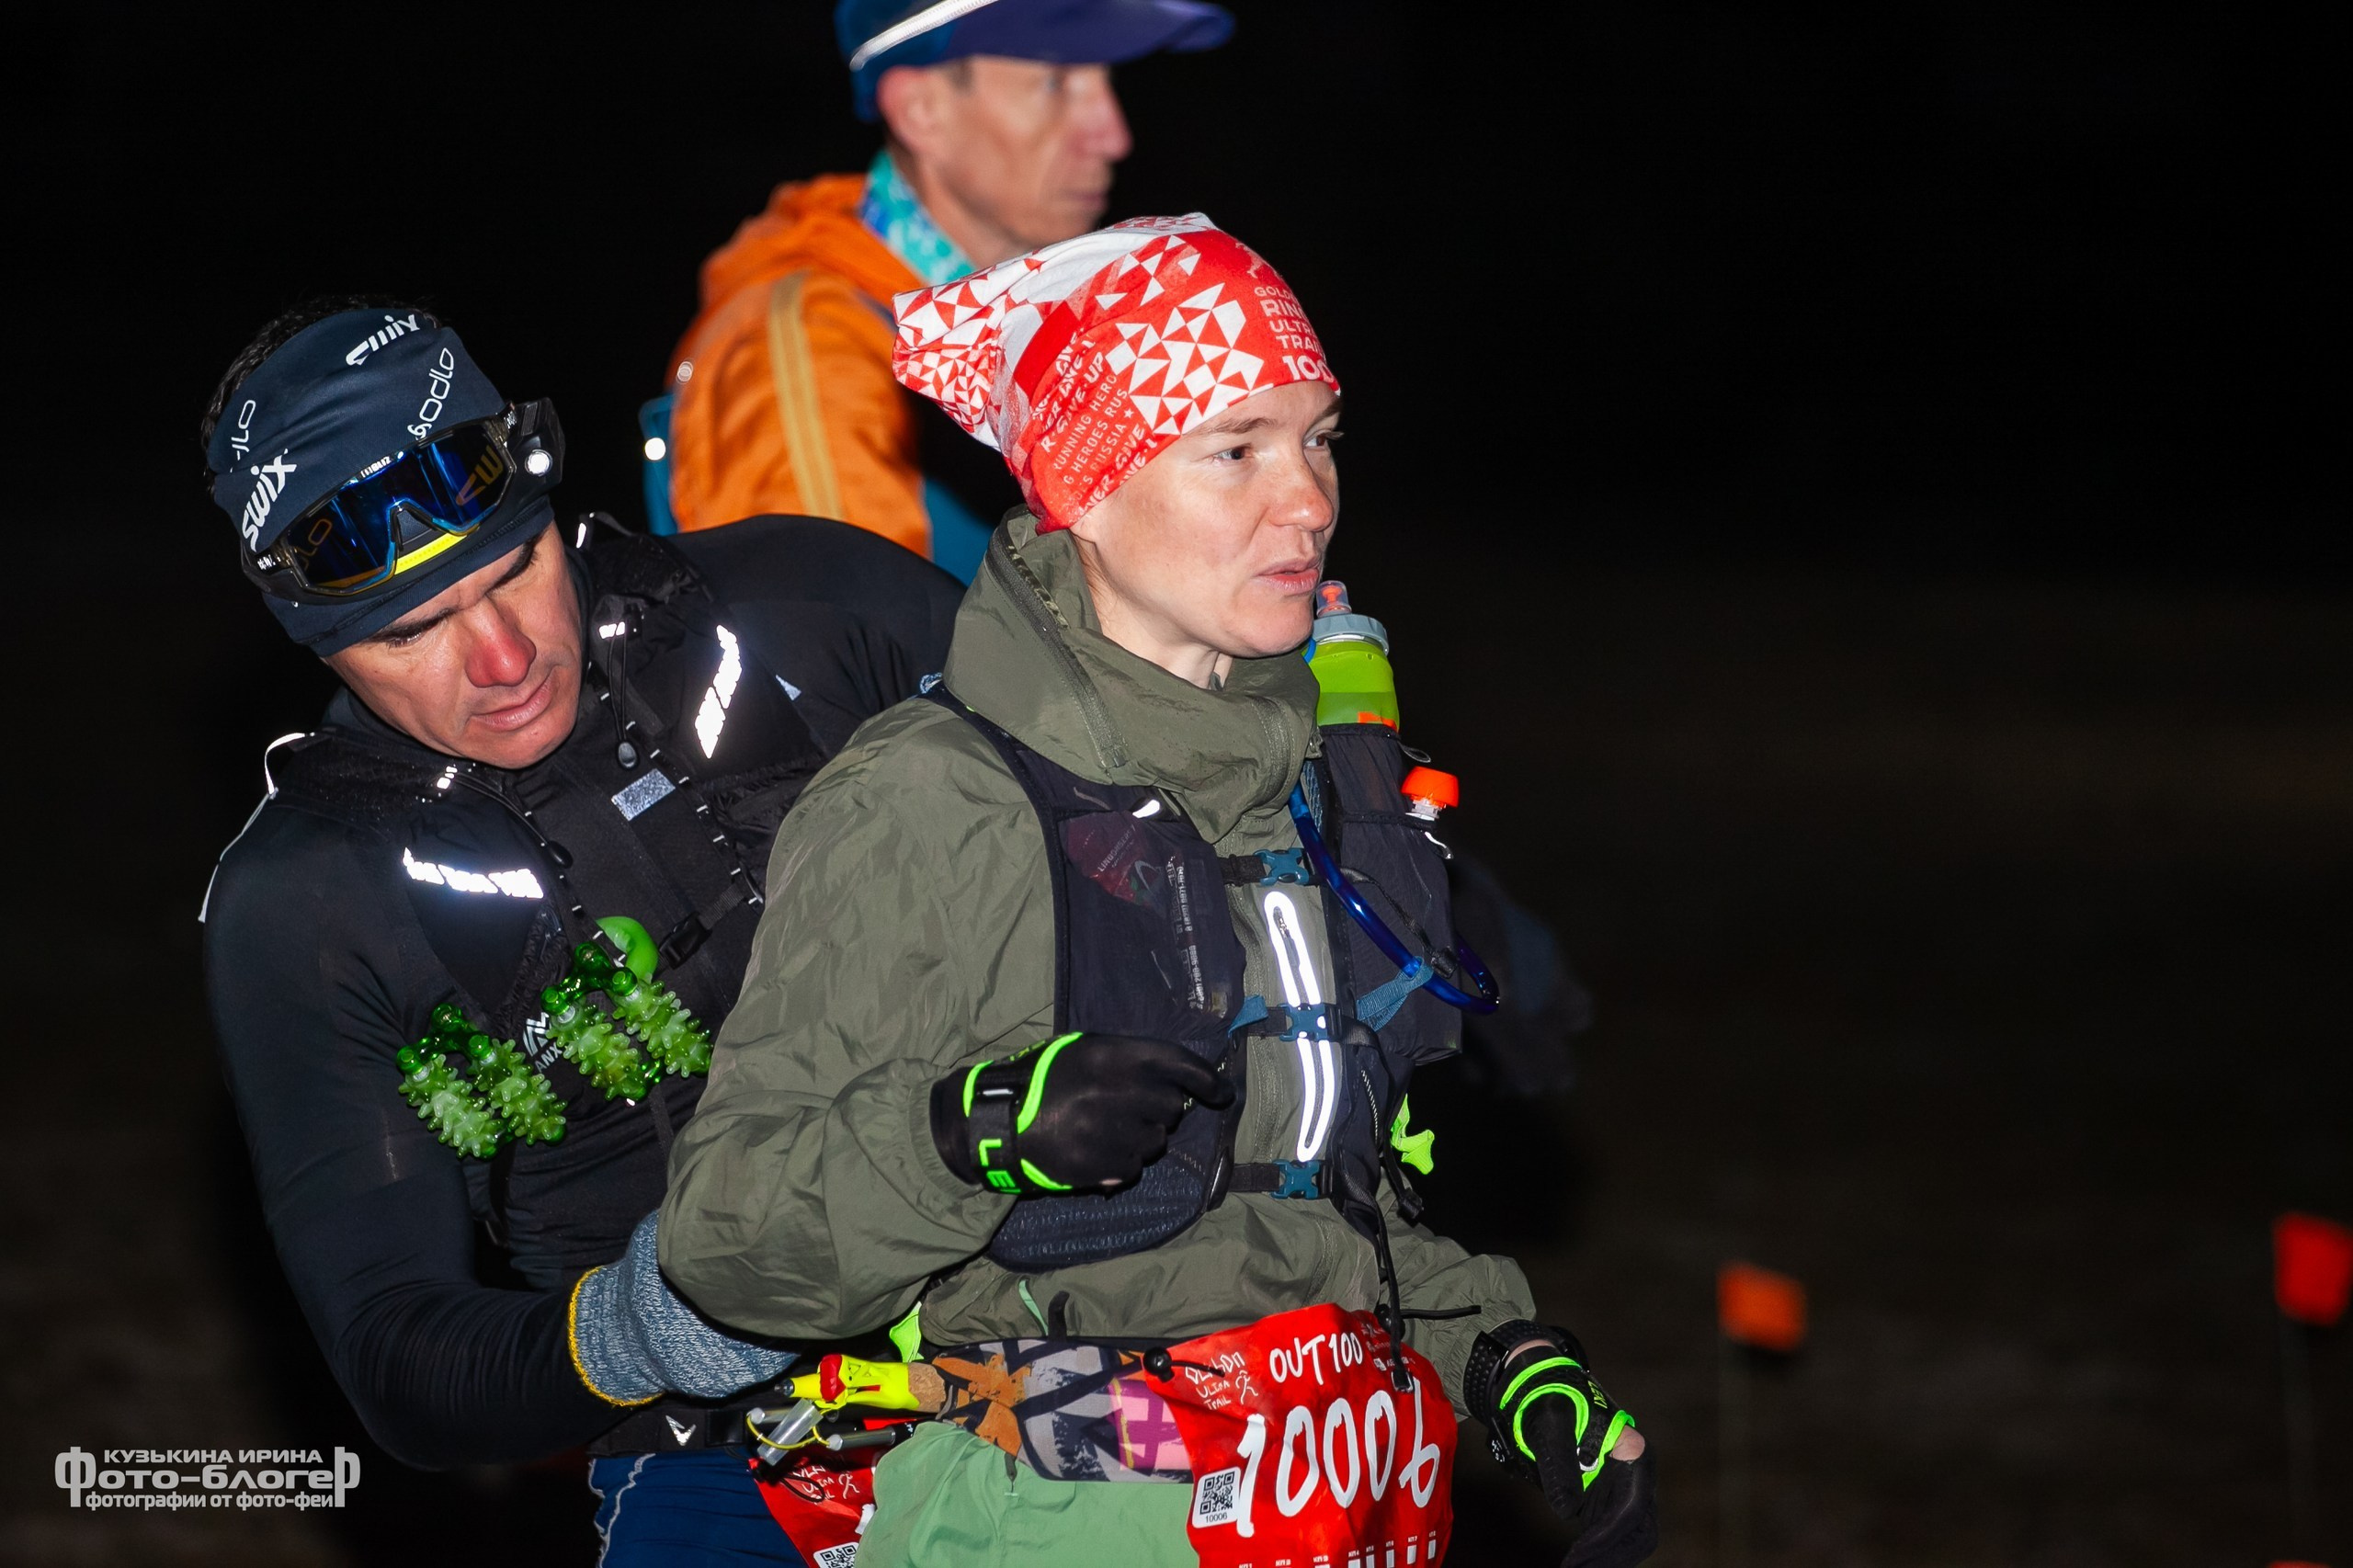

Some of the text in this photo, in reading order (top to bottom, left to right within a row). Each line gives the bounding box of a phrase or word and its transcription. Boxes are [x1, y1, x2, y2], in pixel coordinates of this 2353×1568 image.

[1254, 286, 1299, 304] GOLD
[1072, 420, 1108, 472] HEROES
[1236, 1377, 1440, 1538] 10006
[1205, 1512, 1228, 1523] 10006
